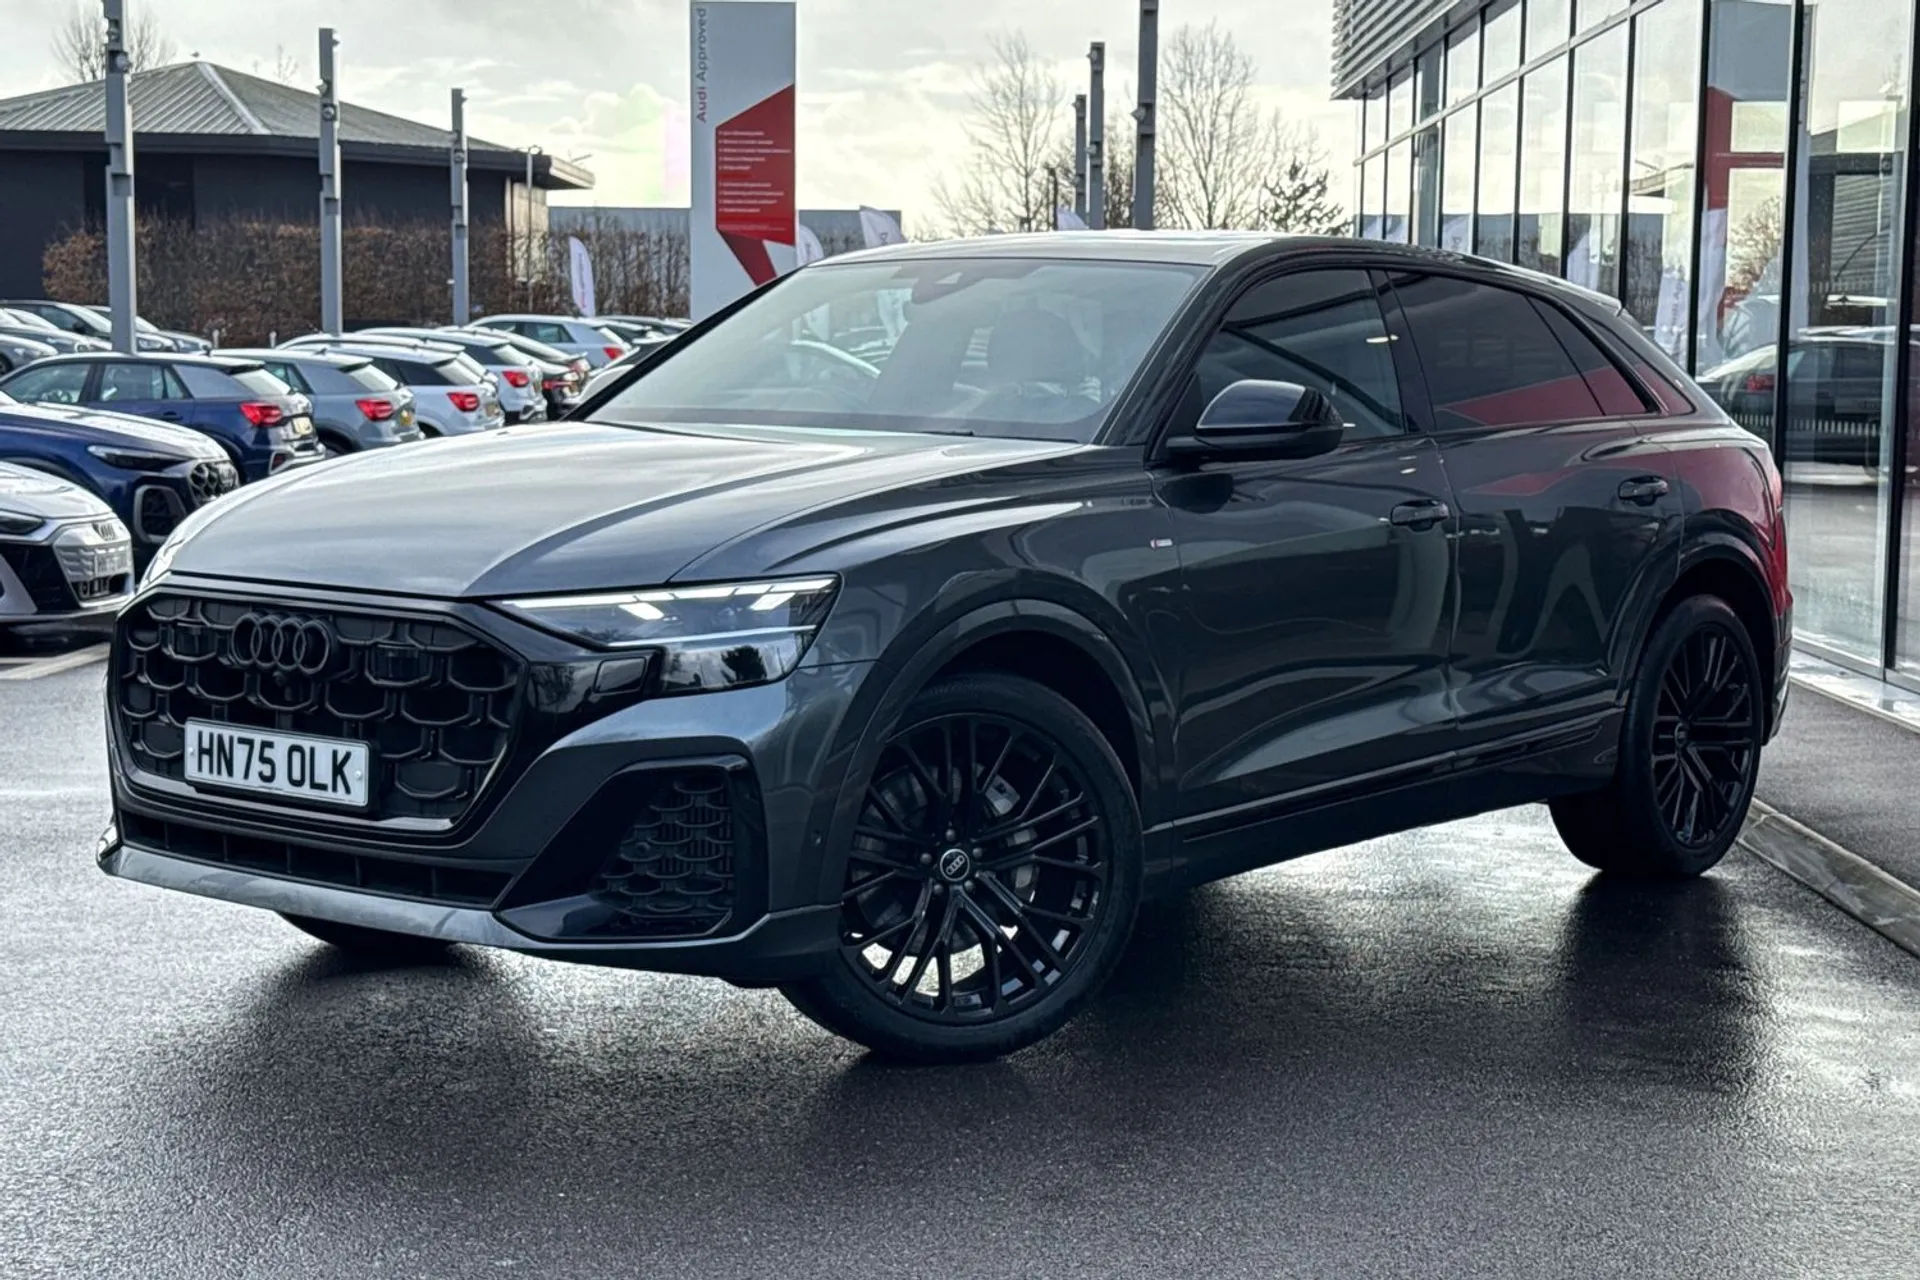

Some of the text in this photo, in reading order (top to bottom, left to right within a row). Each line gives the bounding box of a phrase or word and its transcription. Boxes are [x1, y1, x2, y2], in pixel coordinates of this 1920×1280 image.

[696, 8, 708, 123] Audi Approved
[197, 730, 352, 795] HN75 OLK
